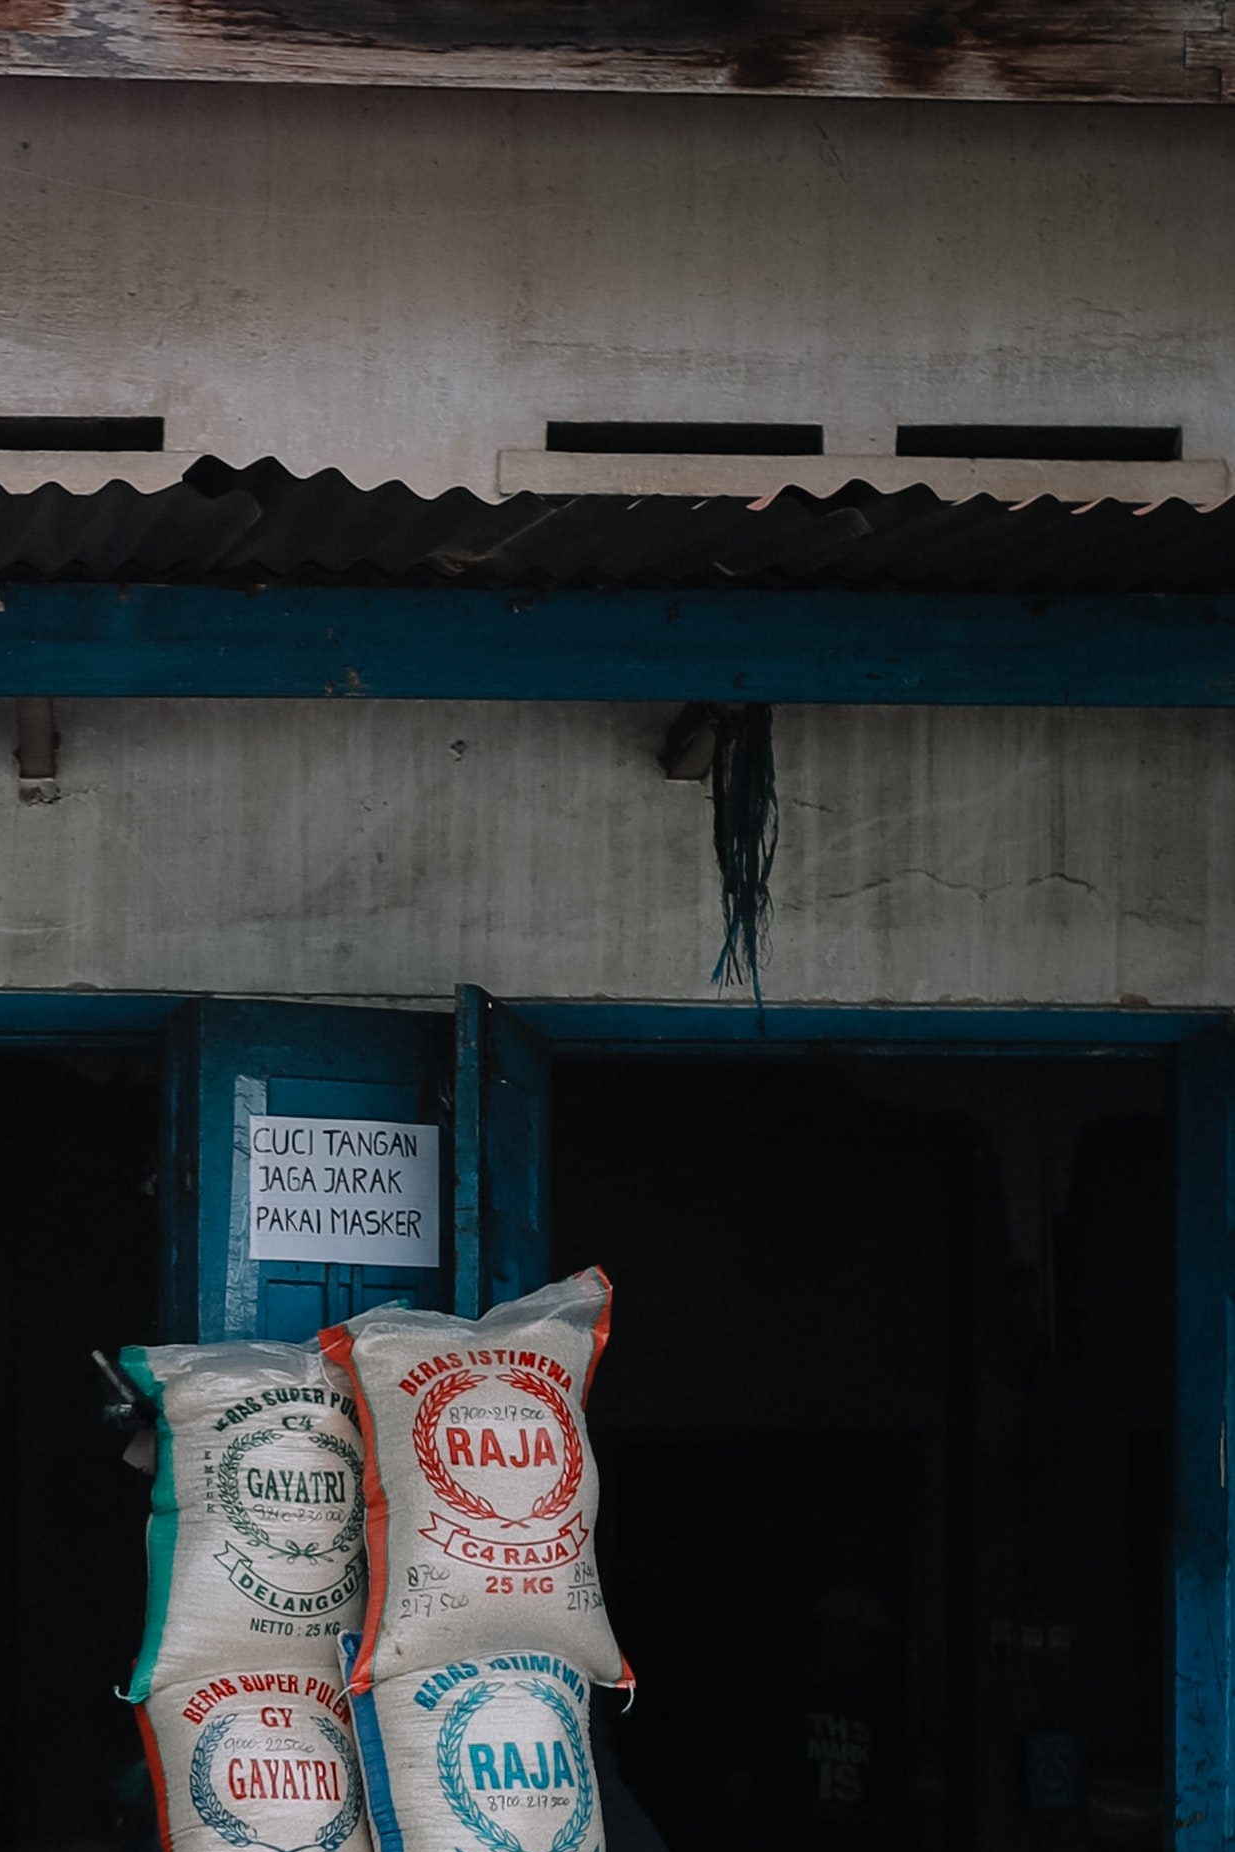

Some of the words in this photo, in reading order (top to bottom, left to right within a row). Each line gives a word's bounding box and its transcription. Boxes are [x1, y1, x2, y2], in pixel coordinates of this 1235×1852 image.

[253, 1128, 314, 1156] CUCI
[323, 1130, 418, 1158] TANGAN
[258, 1166, 317, 1192] JAGA
[324, 1167, 404, 1194] JARAK
[256, 1206, 321, 1235] PAKAI
[331, 1208, 422, 1239] MASKER
[398, 1352, 463, 1398] BERAS
[468, 1350, 574, 1394] ISTIMEWA
[261, 1387, 326, 1407] SUPER
[282, 1415, 314, 1431] C4
[446, 1426, 558, 1468] RAJA
[247, 1467, 346, 1504] GAYATRI
[461, 1541, 495, 1563] C4
[504, 1544, 570, 1565] RAJA
[238, 1573, 356, 1613] DELANGGU
[485, 1576, 513, 1594] 25
[523, 1576, 554, 1594] KG
[249, 1617, 294, 1636] NETTO
[305, 1623, 320, 1636] 25
[323, 1621, 341, 1636] KG
[182, 1677, 239, 1726] BERAS
[238, 1674, 300, 1695] SUPER
[415, 1661, 479, 1712] BERAS
[260, 1706, 294, 1729] GY
[228, 1758, 342, 1802] GAYATRI
[468, 1741, 576, 1790] RAJA
[819, 1762, 863, 1801] IS
